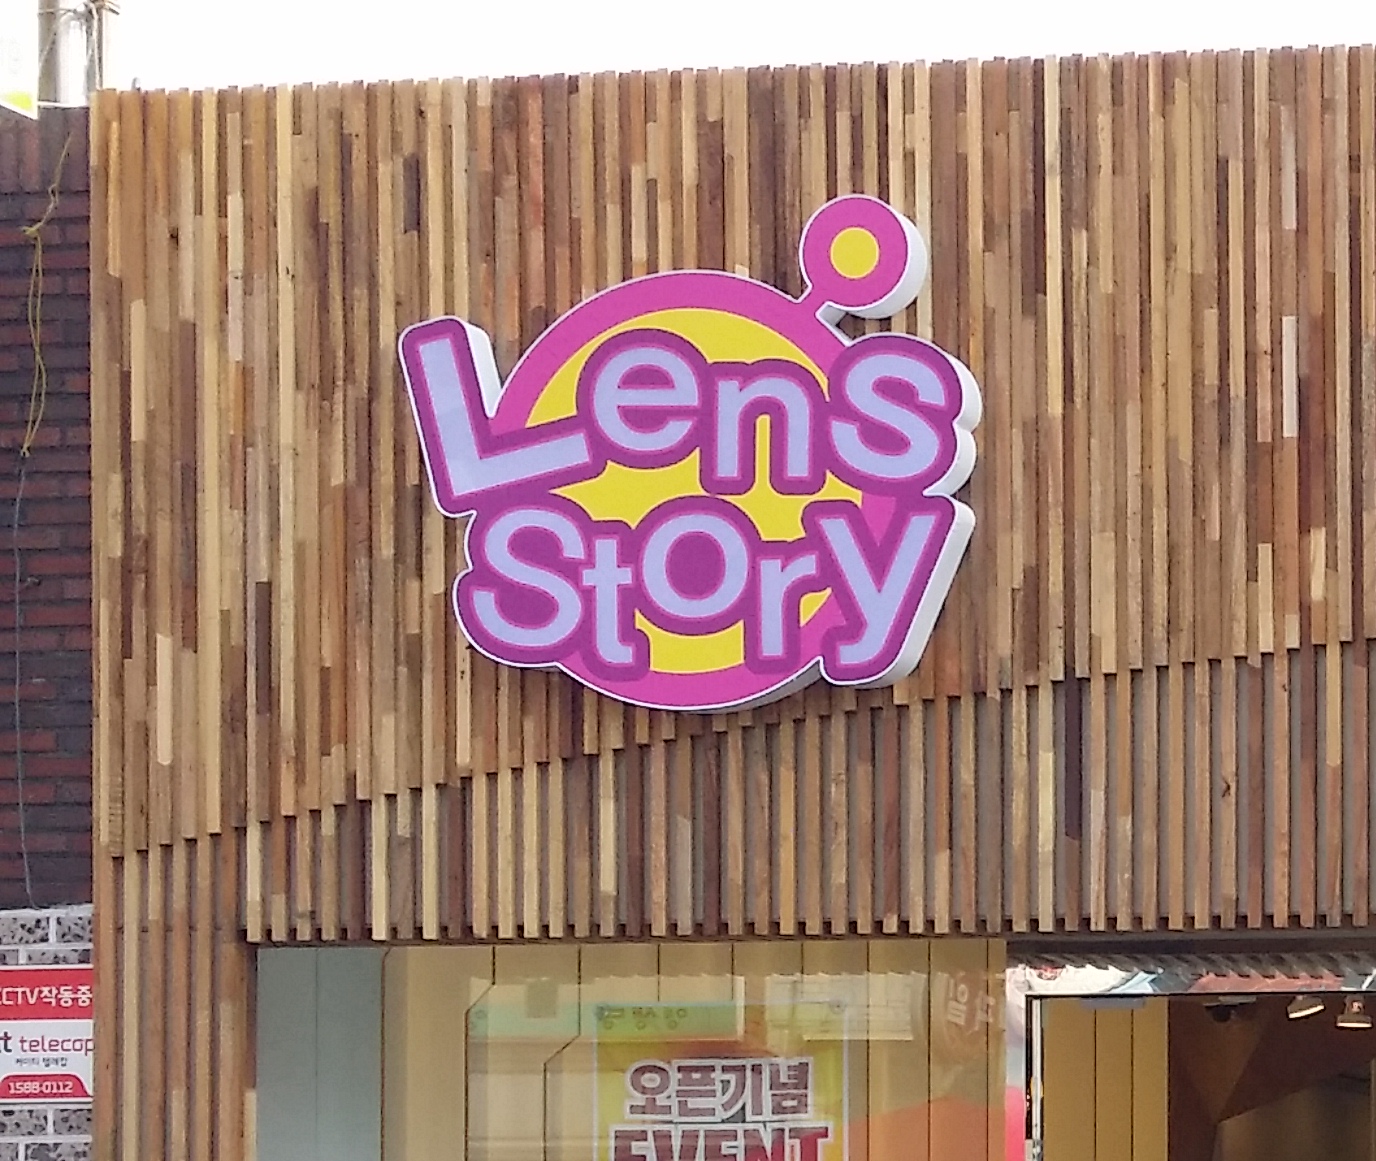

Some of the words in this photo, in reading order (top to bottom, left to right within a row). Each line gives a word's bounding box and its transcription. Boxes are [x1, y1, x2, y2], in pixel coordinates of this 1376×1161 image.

[419, 338, 946, 497] Lens
[473, 508, 936, 666] Story
[0, 985, 93, 1008] CTV작동중
[19, 1035, 94, 1057] telecop
[628, 1059, 812, 1118] 오픈기념
